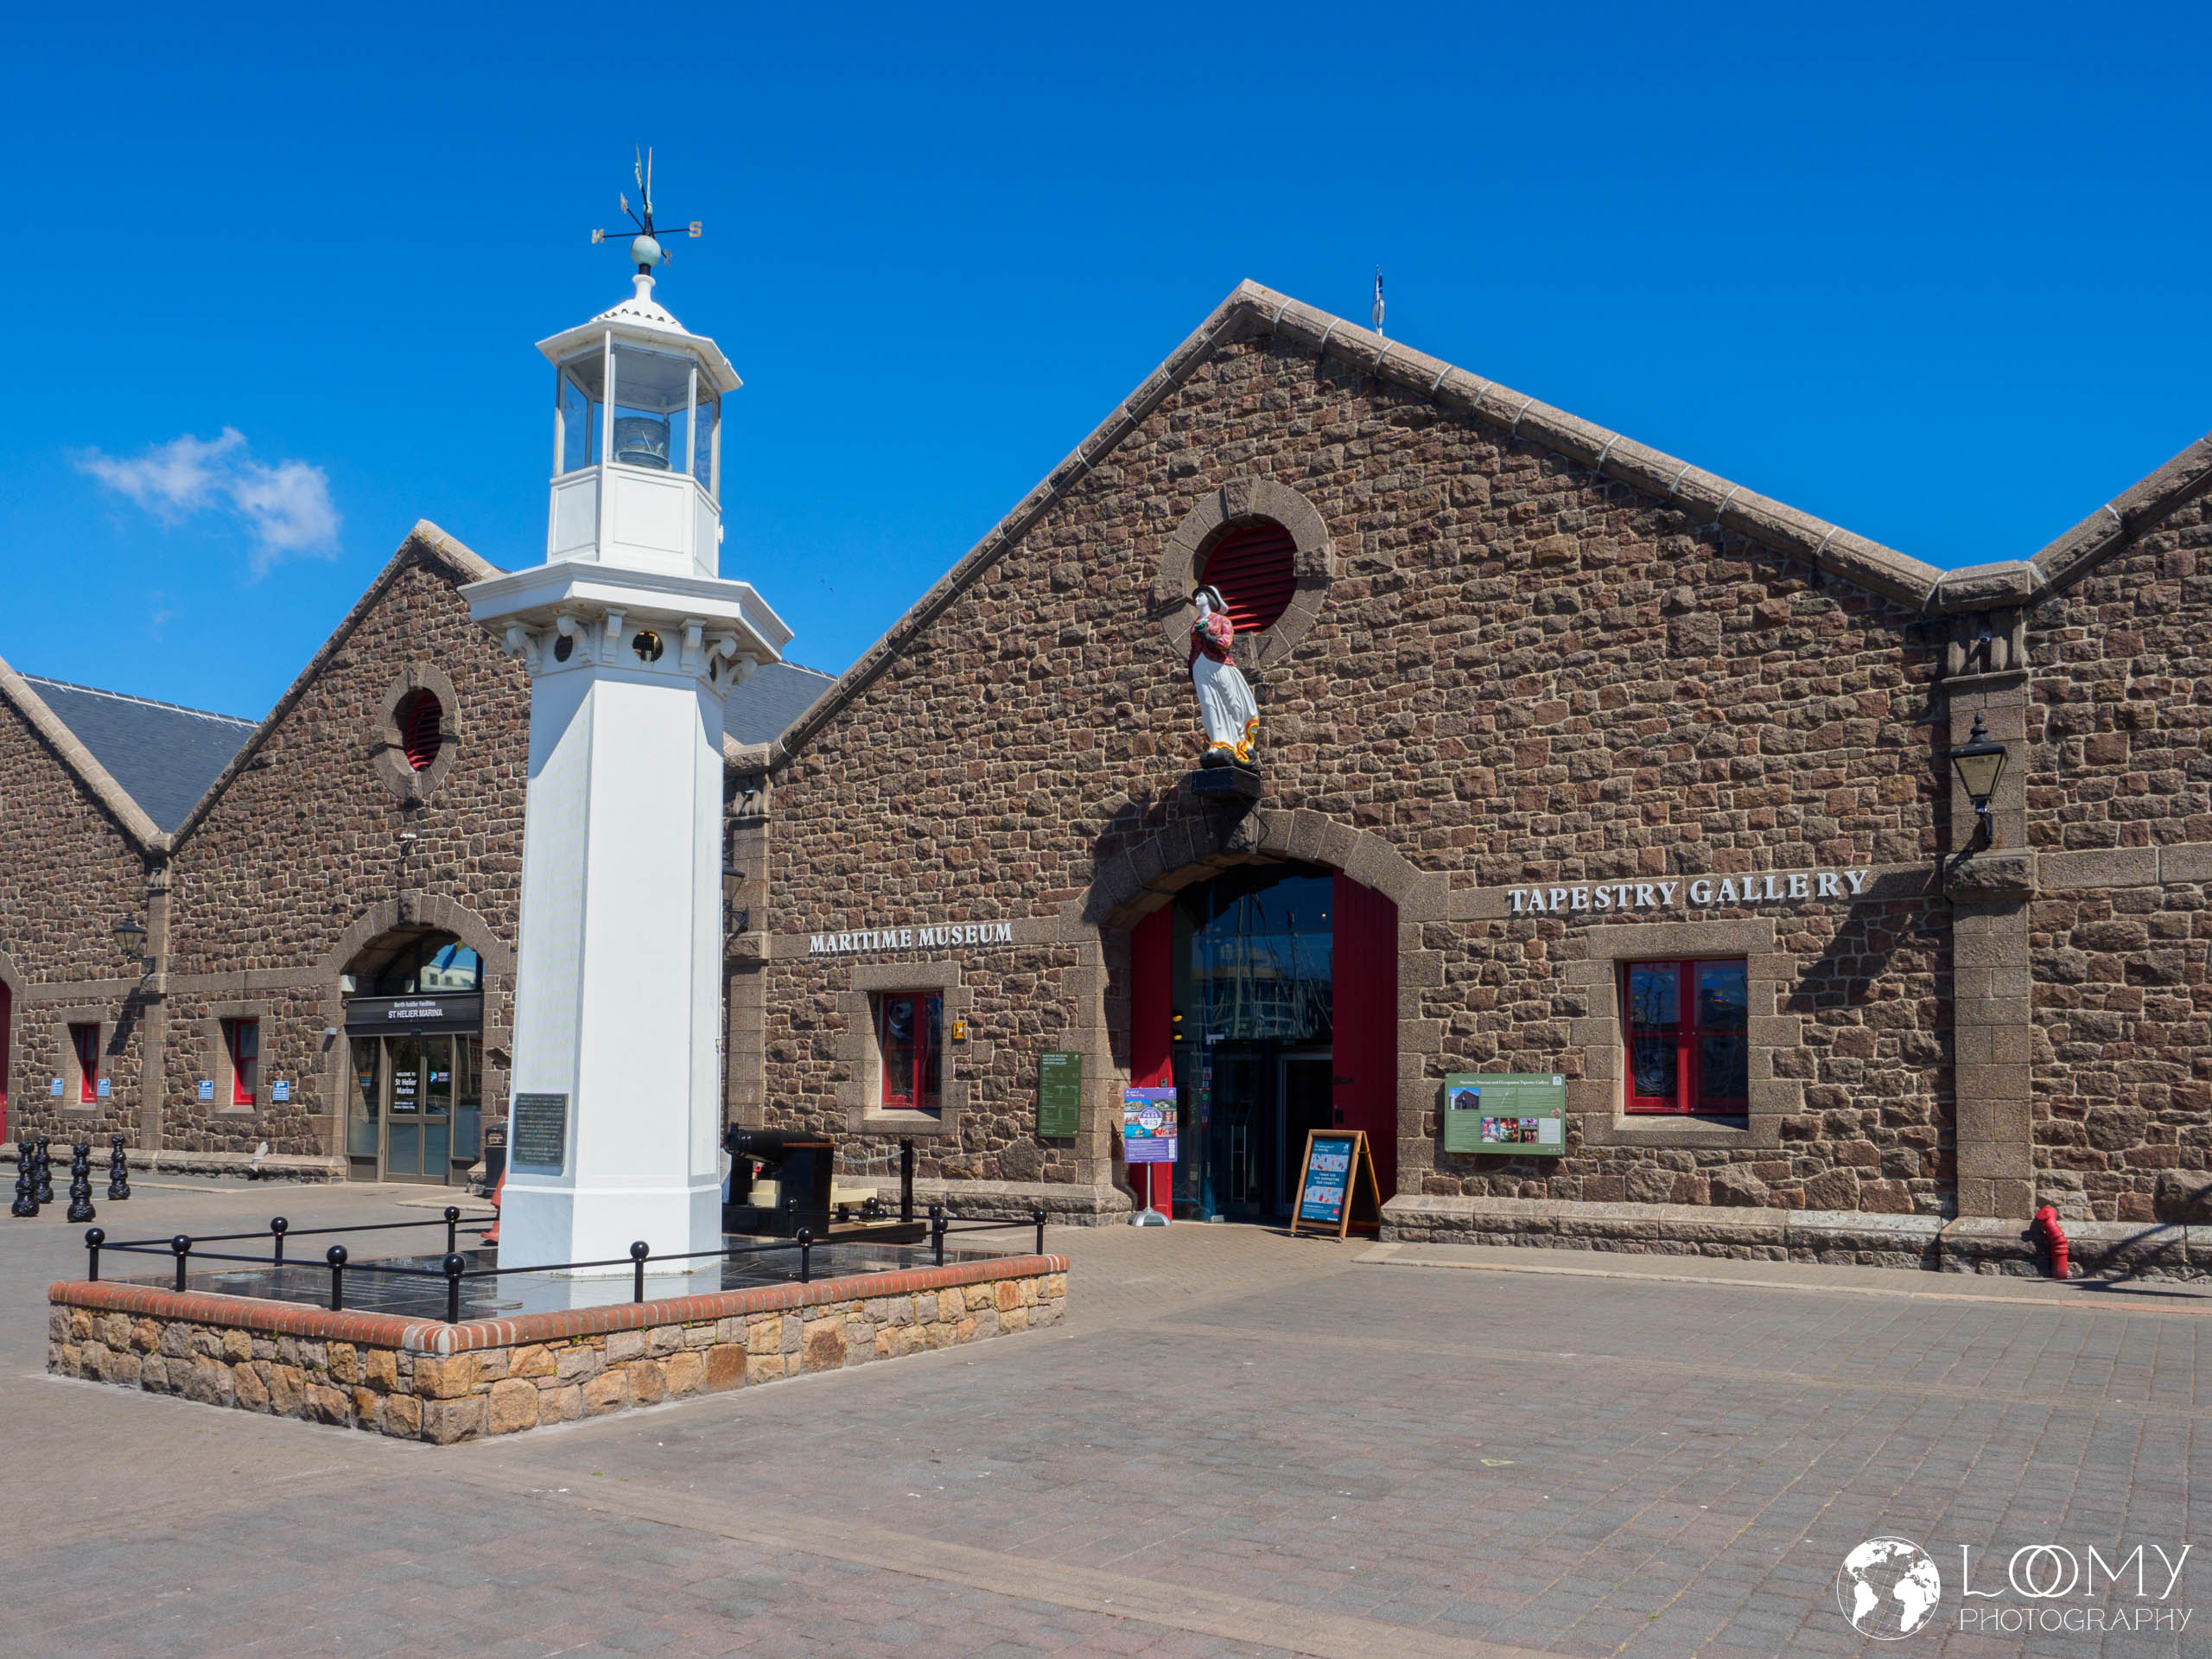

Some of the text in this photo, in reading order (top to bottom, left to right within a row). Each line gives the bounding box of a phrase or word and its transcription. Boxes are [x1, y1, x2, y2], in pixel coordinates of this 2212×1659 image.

[1508, 869, 1869, 912] TAPESTRY GALLERY
[809, 922, 1013, 953] MARITIME MUSEUM
[388, 1008, 442, 1019] ST HELIER MARINA
[402, 1077, 417, 1086] Helier
